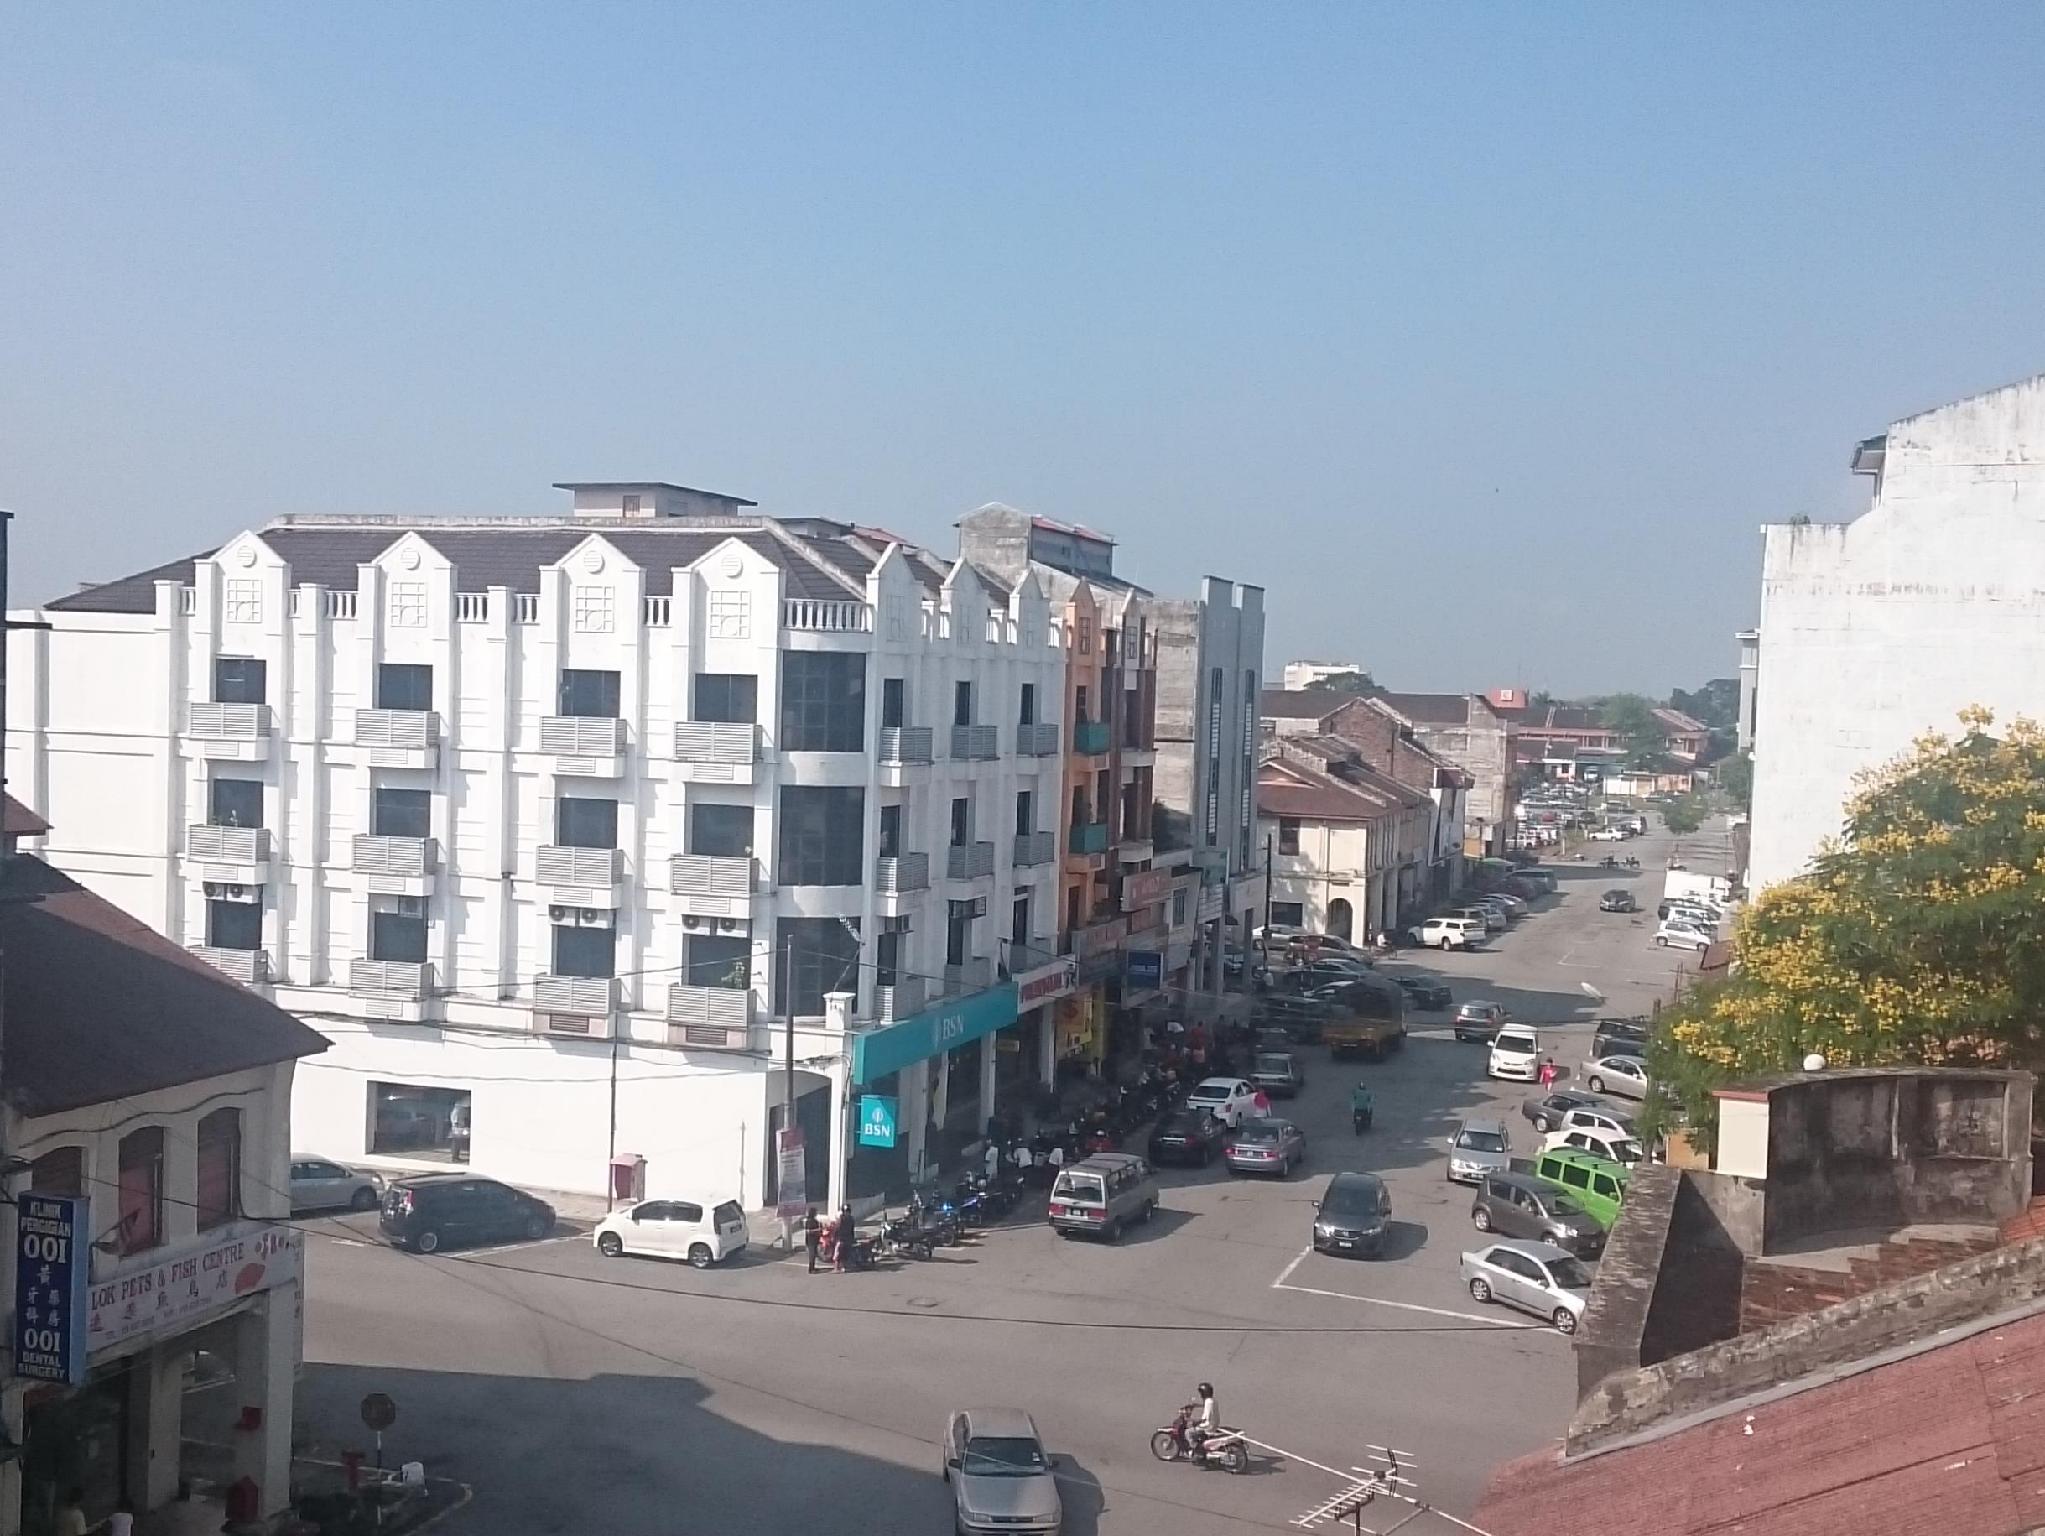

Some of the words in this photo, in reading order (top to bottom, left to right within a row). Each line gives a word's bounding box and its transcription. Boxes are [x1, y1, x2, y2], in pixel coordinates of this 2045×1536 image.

[943, 1013, 964, 1040] BSN
[864, 1122, 891, 1138] BSN
[24, 1234, 67, 1264] OOI
[91, 1285, 115, 1311] LOK
[121, 1273, 152, 1300] PETS
[171, 1257, 198, 1283] FISH
[202, 1242, 245, 1272] CENTRE
[24, 1328, 61, 1352] OOI
[18, 1362, 66, 1379] SURGERY
[22, 1351, 61, 1368] DENTAL
